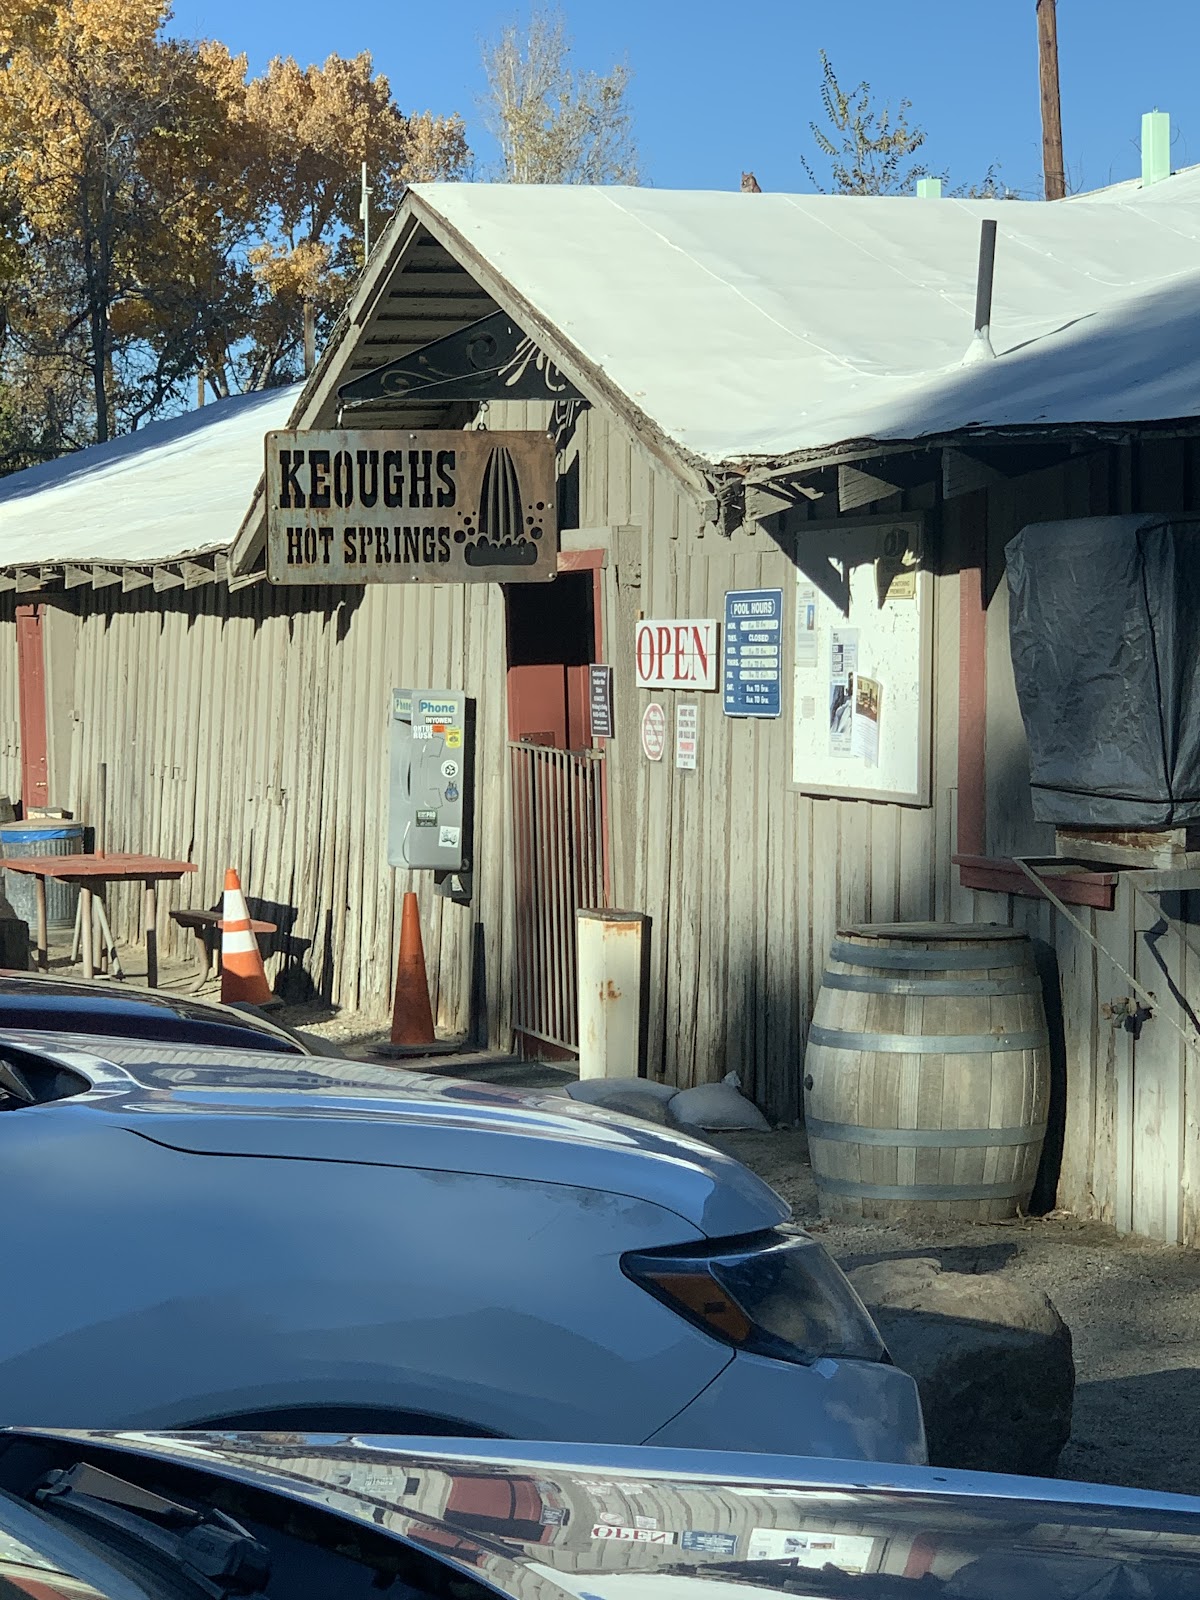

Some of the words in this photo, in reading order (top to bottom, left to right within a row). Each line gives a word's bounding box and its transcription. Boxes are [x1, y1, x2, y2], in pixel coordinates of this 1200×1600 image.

[279, 450, 456, 508] KEOUGHS
[286, 527, 334, 564] HOT
[344, 526, 451, 564] SPRINGS
[733, 603, 750, 614] POOL
[751, 602, 773, 614] HOURS
[748, 634, 769, 642] CLOSED
[637, 625, 710, 681] OPEN
[420, 702, 455, 713] Phone
